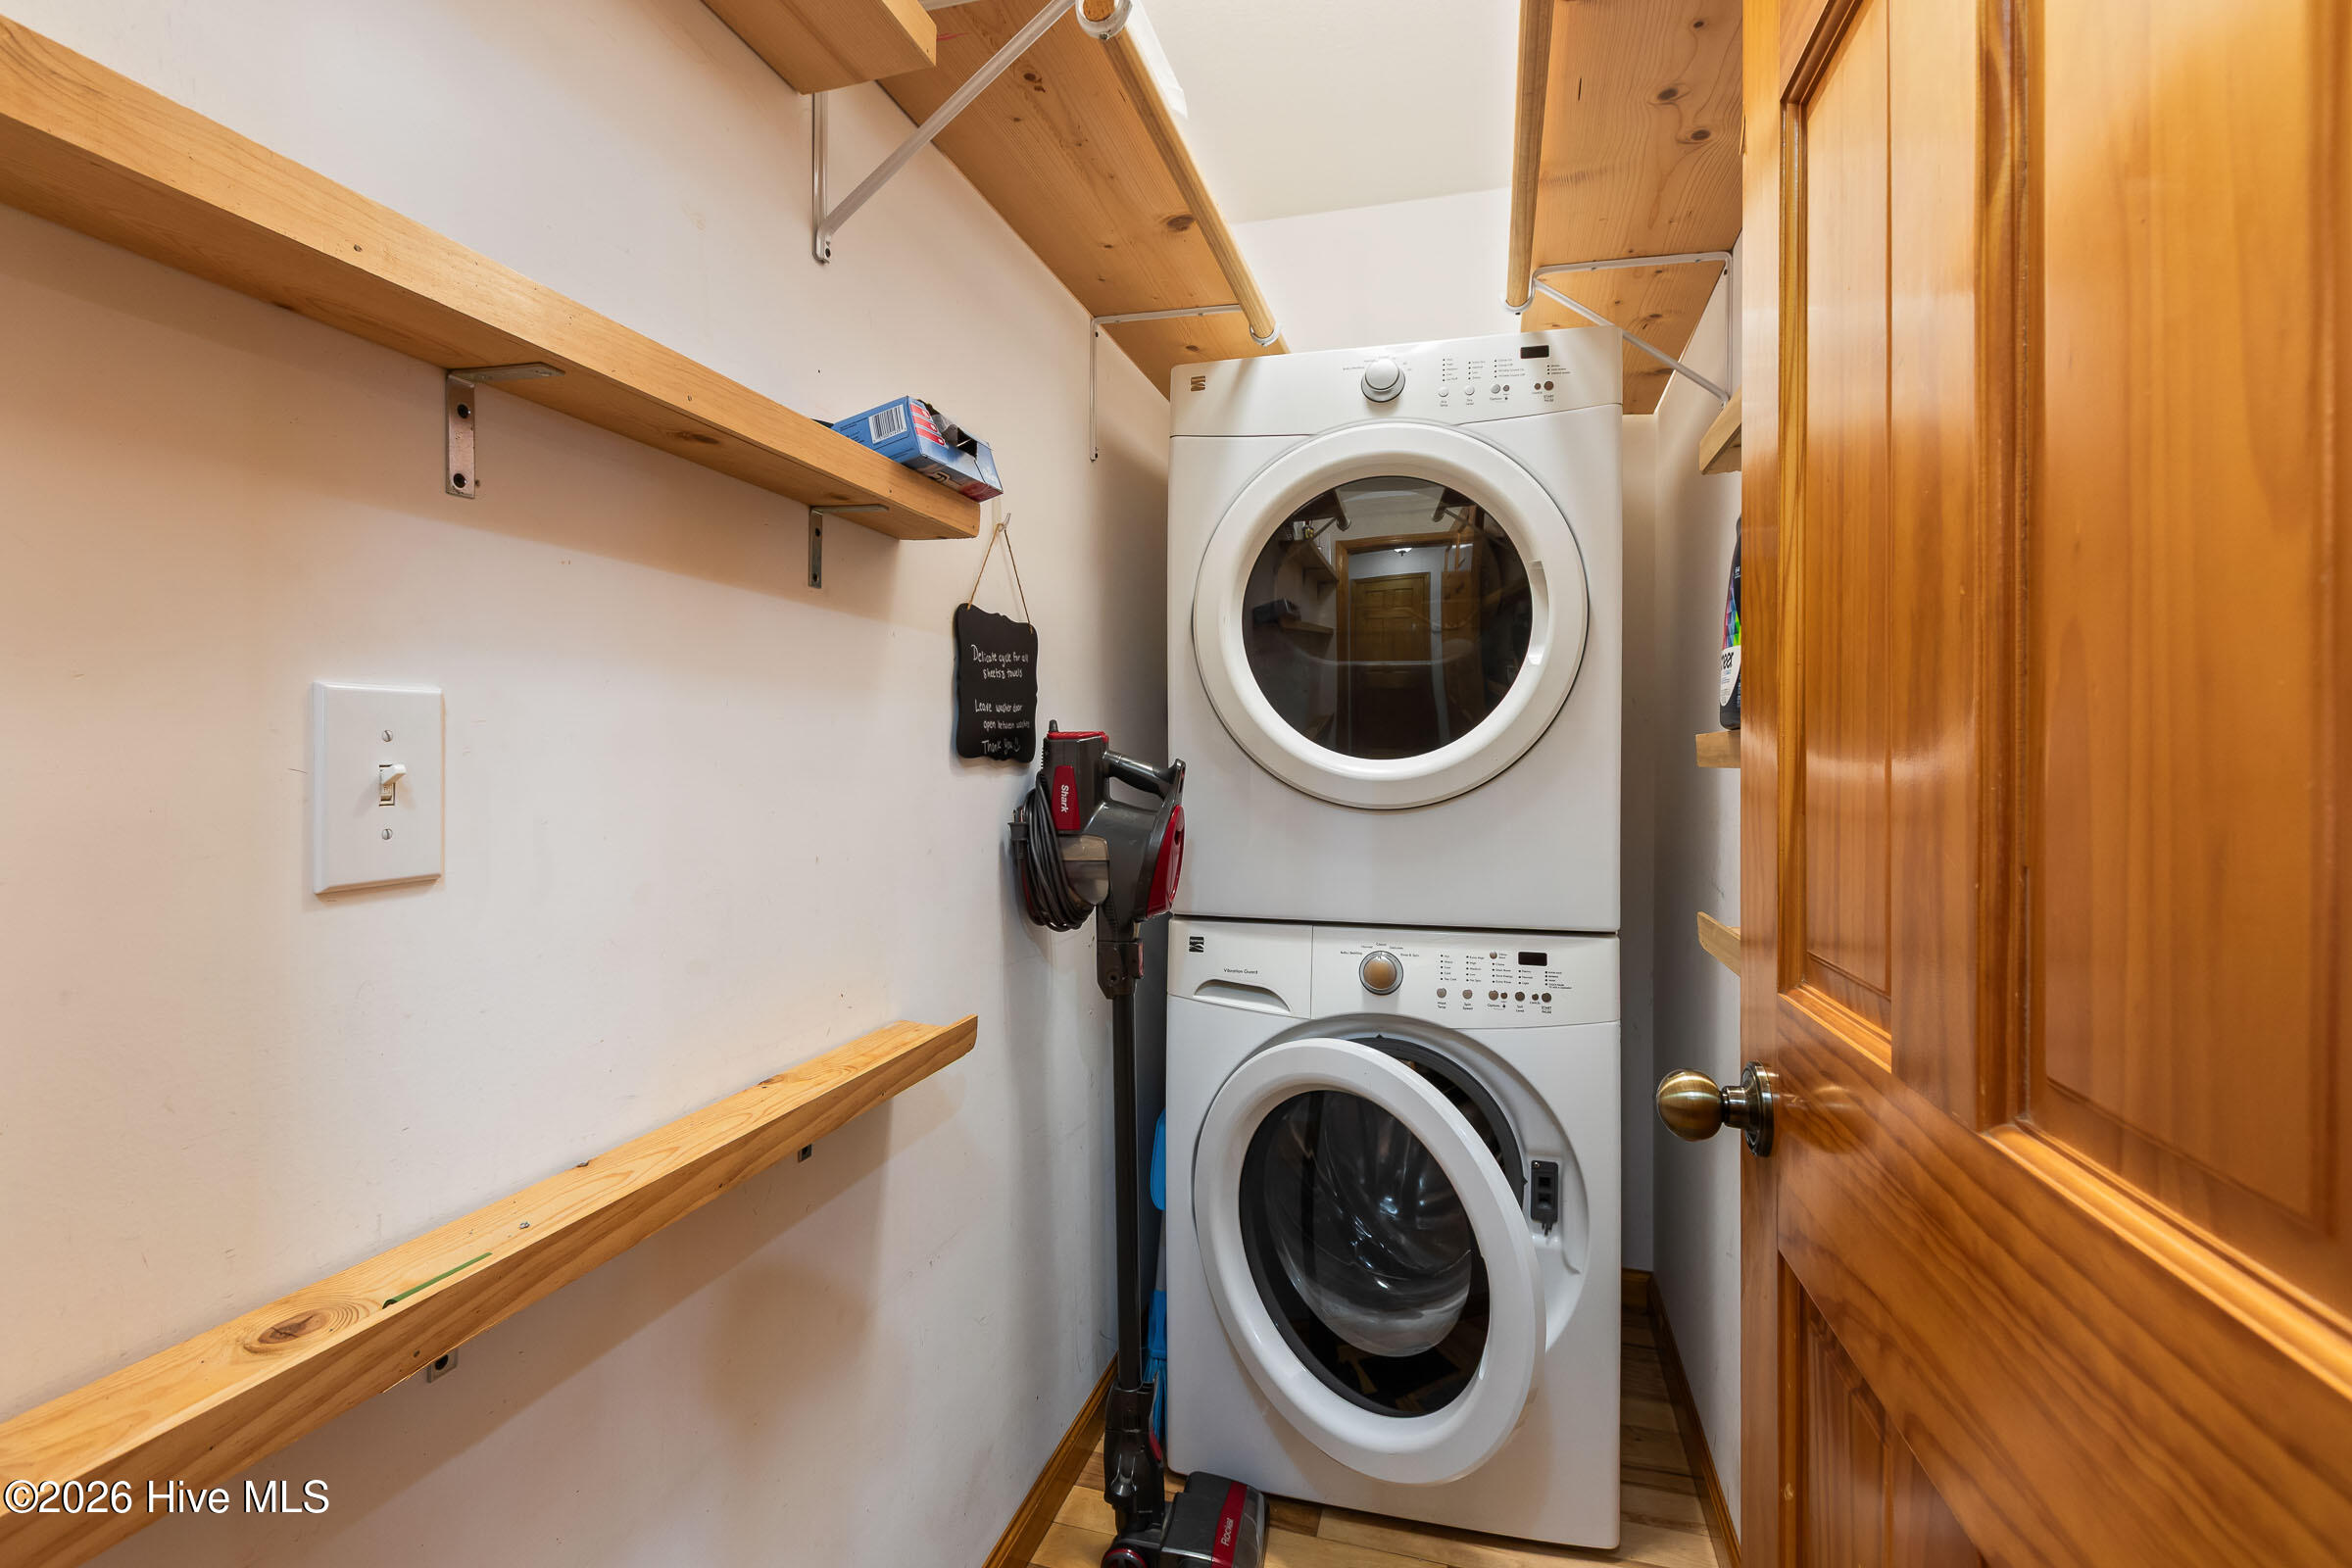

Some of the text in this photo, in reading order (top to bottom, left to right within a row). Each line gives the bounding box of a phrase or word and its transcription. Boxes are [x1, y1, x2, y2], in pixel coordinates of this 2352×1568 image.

[970, 644, 998, 662] Delicate
[974, 699, 993, 712] Leave
[983, 720, 997, 732] open
[981, 739, 1002, 755] Thank
[1060, 784, 1069, 812] Shark
